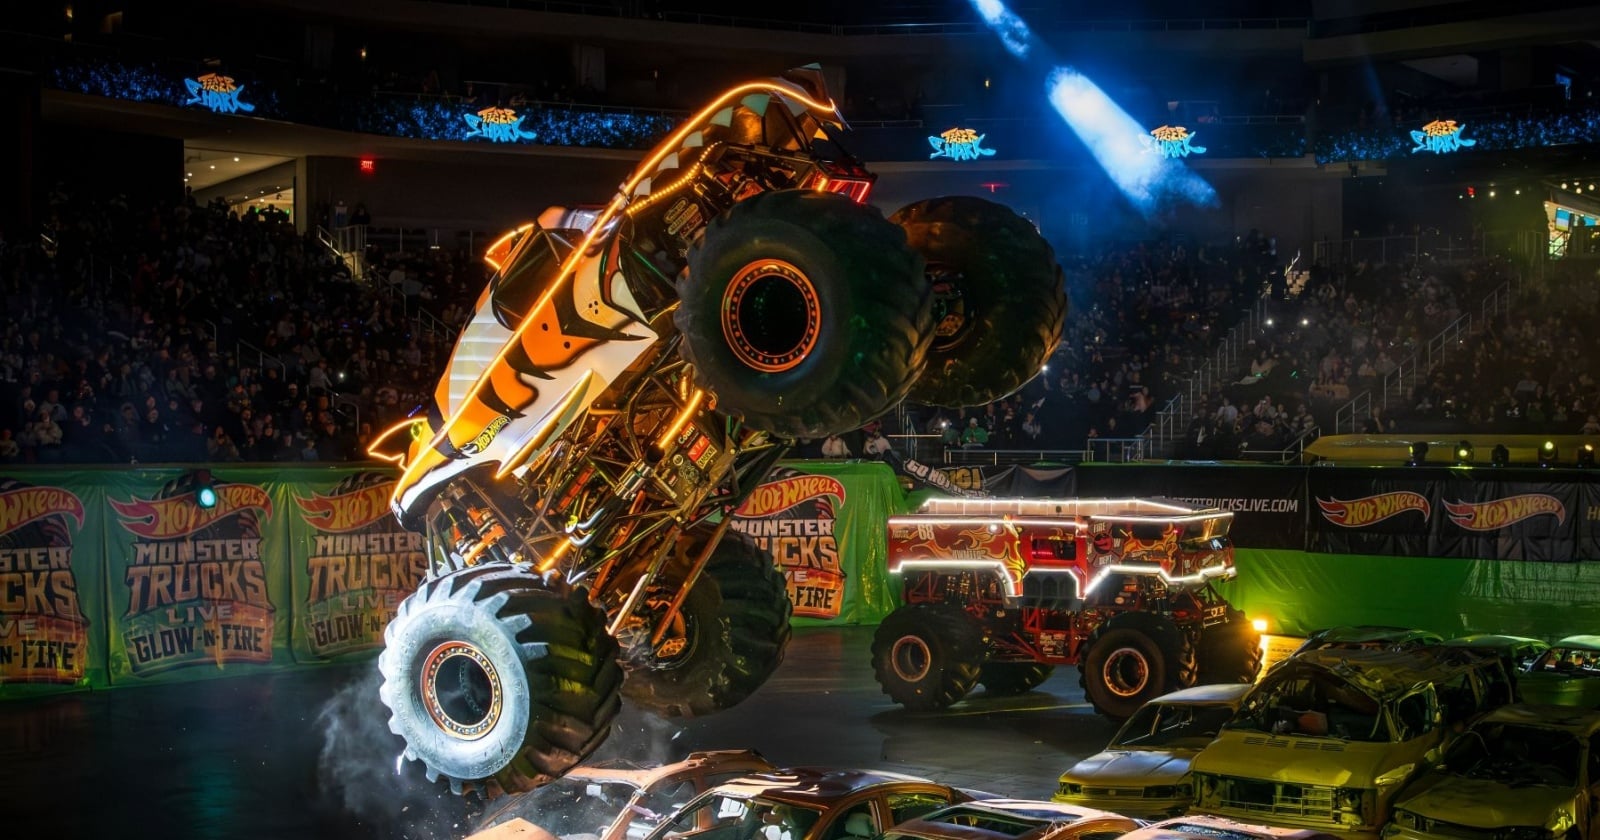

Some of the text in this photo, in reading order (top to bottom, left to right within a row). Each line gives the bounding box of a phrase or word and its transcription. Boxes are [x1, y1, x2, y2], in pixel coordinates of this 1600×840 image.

[184, 78, 255, 113] SHARK
[464, 113, 536, 142] SHARK
[478, 106, 518, 123] TIGER
[928, 133, 996, 161] SHARK
[1410, 124, 1476, 154] SHARK
[329, 496, 370, 529] HOT
[746, 487, 780, 515] HOT
[1343, 501, 1376, 525] HOT
[731, 519, 833, 537] MONSTER
[1472, 503, 1506, 528] HOT
[315, 532, 424, 556] MONSTER
[917, 523, 935, 540] 68
[135, 539, 260, 566] MONSTER
[754, 536, 842, 575] UCKS
[126, 560, 270, 616] TRUCKS
[308, 552, 427, 606] TRUCKS
[167, 604, 233, 623] LIVE
[342, 594, 400, 610] LIVE
